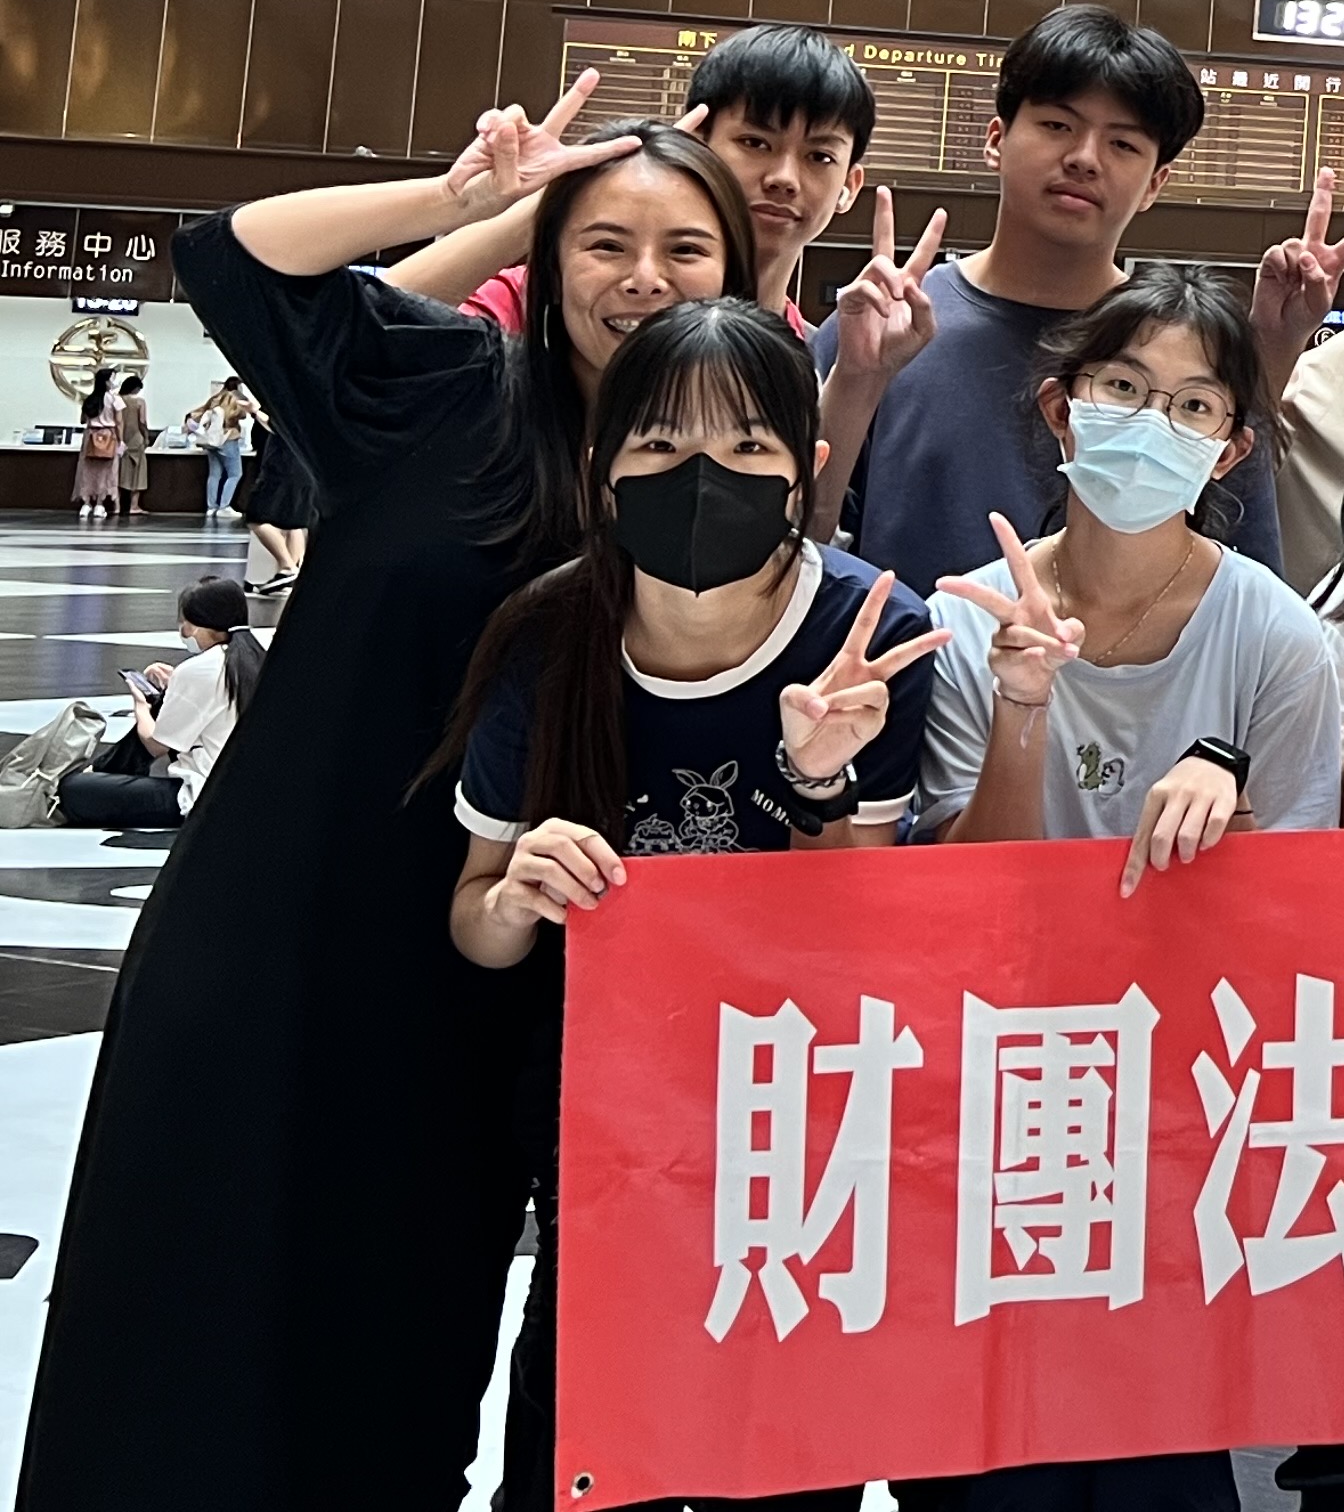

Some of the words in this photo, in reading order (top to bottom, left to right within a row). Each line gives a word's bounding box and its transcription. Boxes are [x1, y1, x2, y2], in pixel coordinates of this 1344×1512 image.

[864, 44, 967, 66] Departure
[0, 228, 156, 261] 服務中心
[1, 259, 133, 284] Information
